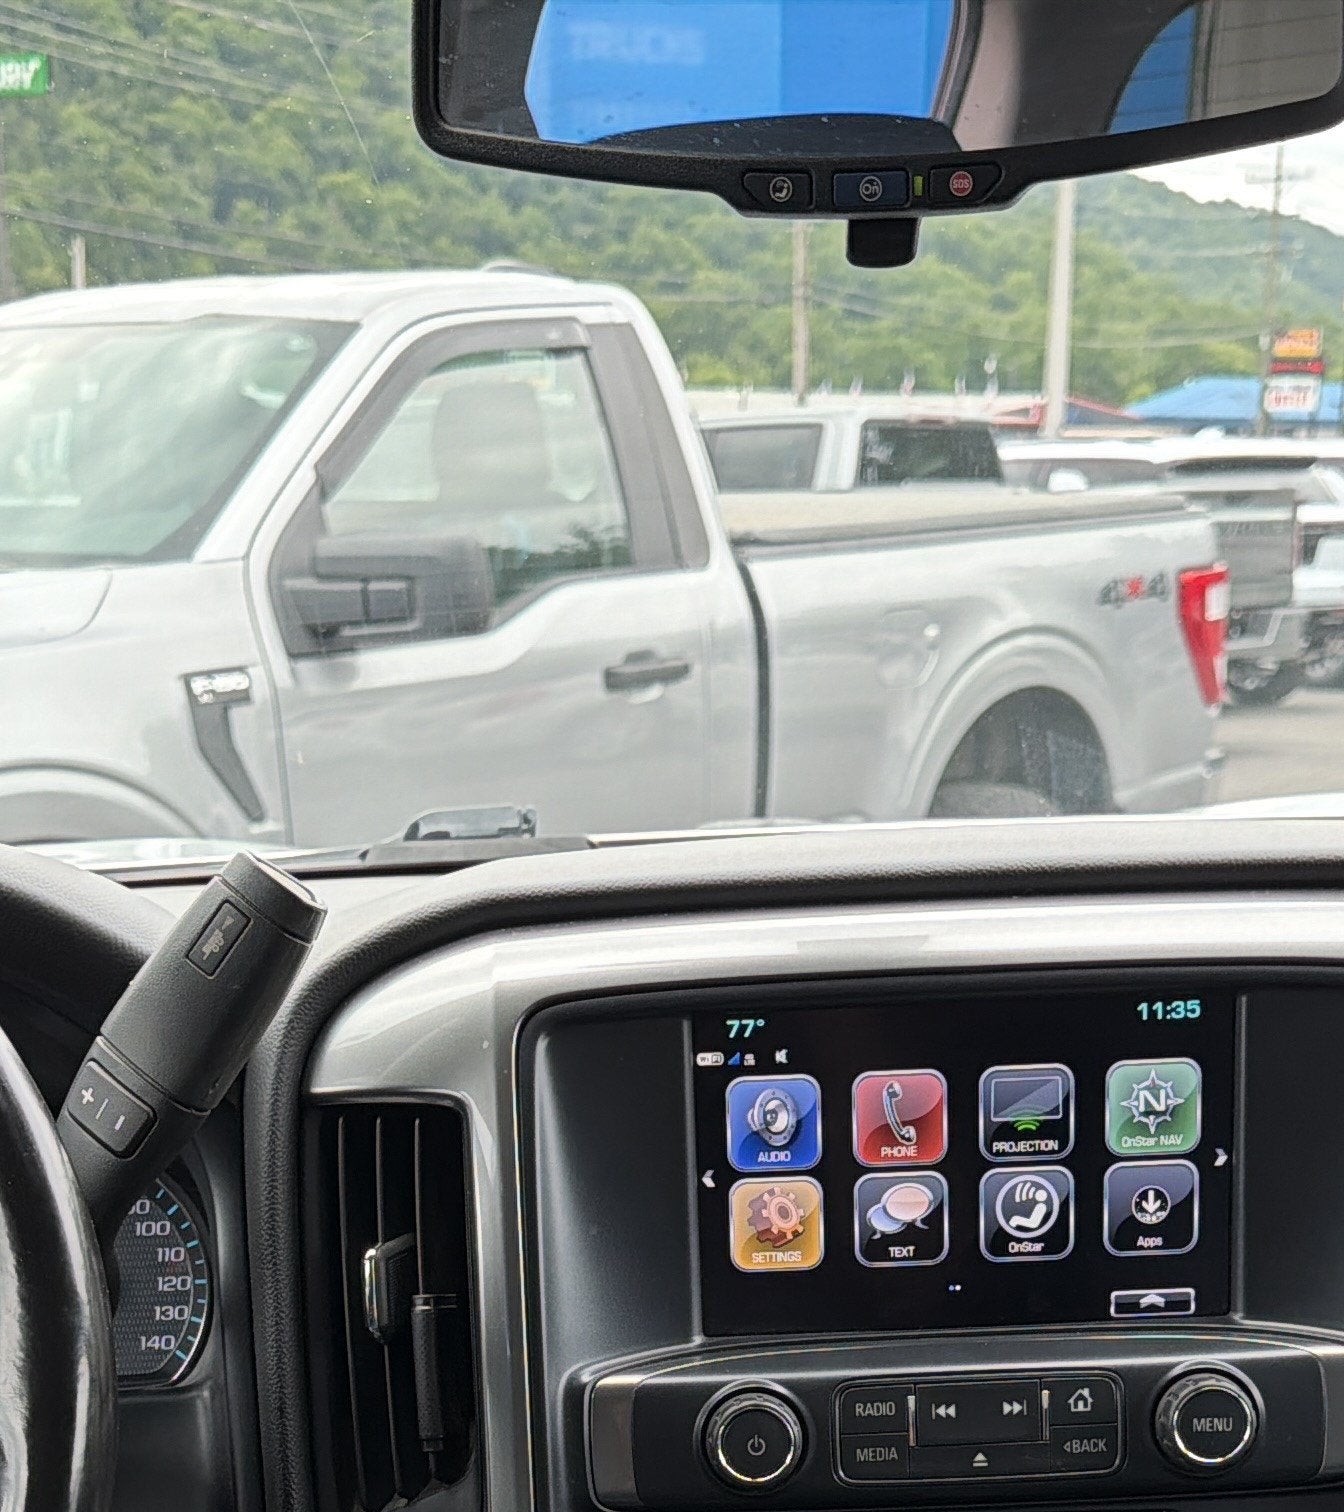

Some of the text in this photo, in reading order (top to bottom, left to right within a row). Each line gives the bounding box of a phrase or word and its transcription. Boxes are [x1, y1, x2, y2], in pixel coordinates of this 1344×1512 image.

[952, 178, 971, 190] SOS
[1136, 999, 1202, 1021] 11:35
[992, 1140, 1059, 1153] PROJECTION
[1121, 1134, 1184, 1148] OnStar NAV
[757, 1150, 791, 1163] AUDIO
[880, 1145, 918, 1158] PHONE
[134, 1220, 171, 1237] 100
[1008, 1241, 1045, 1254] OnStar
[1136, 1235, 1163, 1248] Apps
[156, 1247, 185, 1262] 110
[751, 1250, 802, 1264] SETTINGS
[888, 1245, 915, 1258] TEXT
[156, 1275, 192, 1292] 120
[154, 1305, 189, 1321] 130
[140, 1335, 176, 1351] 140
[855, 1400, 896, 1418] RADIO
[1192, 1415, 1233, 1434] MENU
[1071, 1437, 1108, 1456] BACK
[855, 1446, 898, 1463] MEDIA
